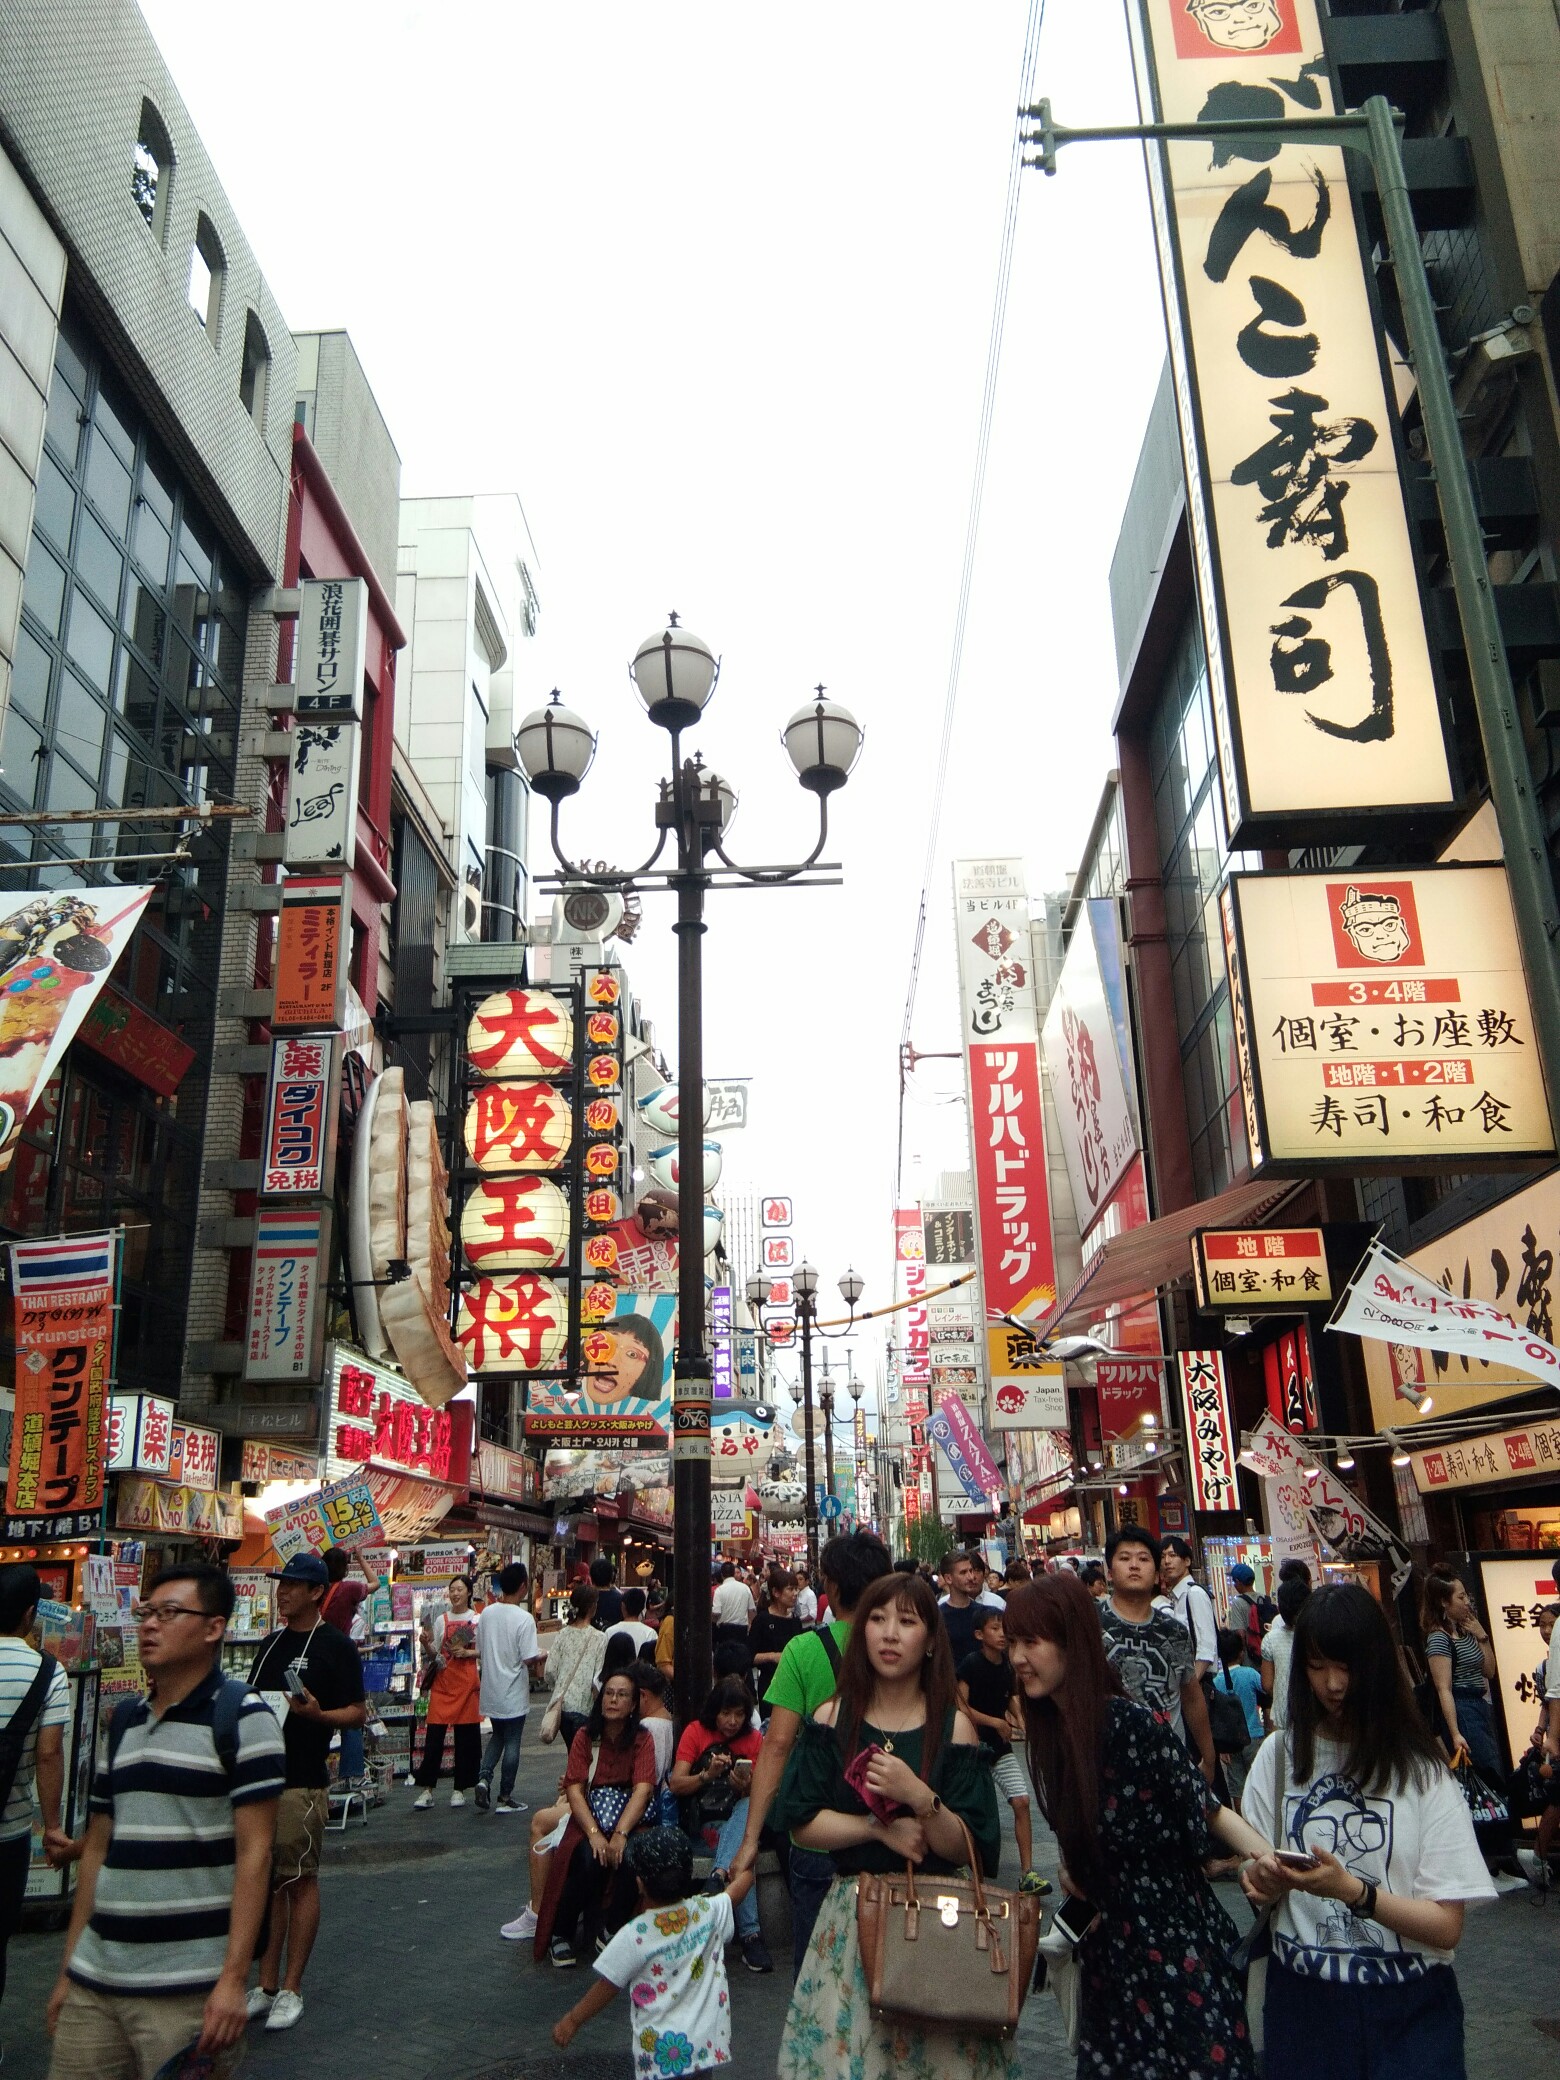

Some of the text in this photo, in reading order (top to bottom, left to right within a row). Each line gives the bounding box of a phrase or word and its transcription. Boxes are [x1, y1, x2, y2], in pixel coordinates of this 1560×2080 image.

[317, 583, 343, 694] 浪花囲碁サロン
[298, 908, 321, 1001] ミティラー
[320, 908, 336, 992] 本格インド料理店 2F
[1271, 1008, 1525, 1053] 個室・お座敷
[283, 1039, 324, 1078] 薬
[277, 1084, 320, 1165] ダイコク
[1308, 1089, 1514, 1138] 寿司・和食
[266, 1168, 319, 1191] 免税
[456, 988, 576, 1371] 大阪王将
[585, 976, 619, 1360] 大阪名物元祖焼餃子
[985, 1051, 1037, 1285] ツルハドラッグ
[944, 1212, 957, 1263] インターネット
[1236, 1236, 1286, 1257] 地階
[20, 1288, 109, 1309] THAI RESTRANT
[1210, 1266, 1323, 1294] 個室・和食
[274, 1259, 296, 1347] クンテープ
[293, 1264, 310, 1360] タイ料理とタイスキの店
[934, 1313, 969, 1322] レインボー
[21, 1325, 107, 1345] Krungtep
[1099, 1365, 1157, 1384] ツルハ
[1101, 1386, 1147, 1400] ドラッグ
[1033, 1395, 1064, 1404] Tax-free
[1044, 1403, 1064, 1412] Shop
[45, 1345, 88, 1510] クンテープ
[142, 1398, 169, 1464] 薬
[1188, 1359, 1233, 1501] 大阪みやげ
[15, 1412, 45, 1510] 道頓堀本店
[184, 1431, 217, 1473] 免税
[677, 1445, 710, 1455] 大阪市
[960, 1425, 993, 1478] ZAZA
[1446, 1442, 1499, 1481] 寿司・和食
[288, 1486, 335, 1513] ダイコク
[710, 1509, 743, 1521] IZZA
[79, 1514, 100, 1532] B1
[332, 1512, 375, 1540] OFF
[731, 1525, 745, 1536] 2F
[425, 1564, 464, 1574] COME IN!
[426, 1556, 464, 1565] STORE FOODS
[1307, 1776, 1335, 1808] BAD
